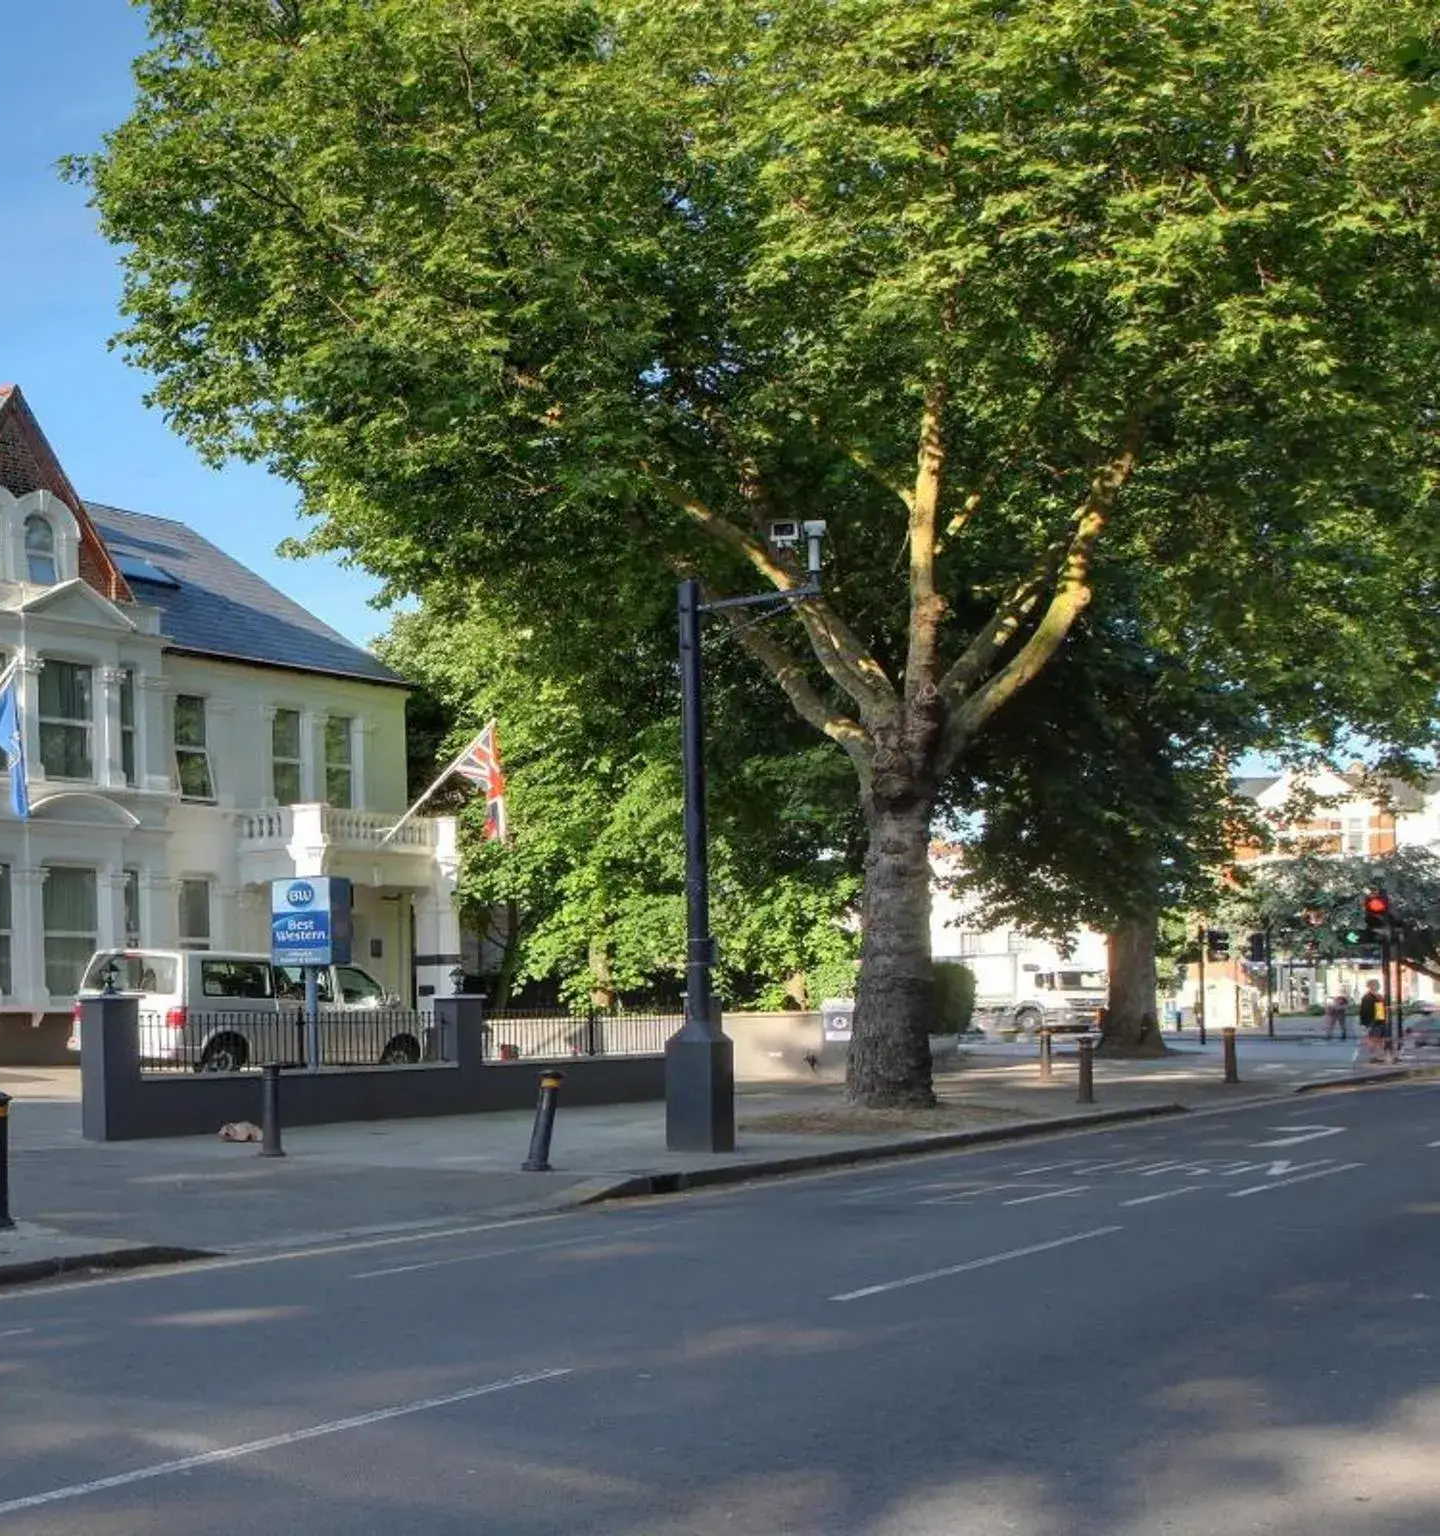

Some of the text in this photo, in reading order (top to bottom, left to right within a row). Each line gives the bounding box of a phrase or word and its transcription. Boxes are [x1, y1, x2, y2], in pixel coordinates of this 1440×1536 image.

[289, 890, 311, 901] BW
[287, 920, 314, 930] Best
[276, 930, 325, 941] Western
